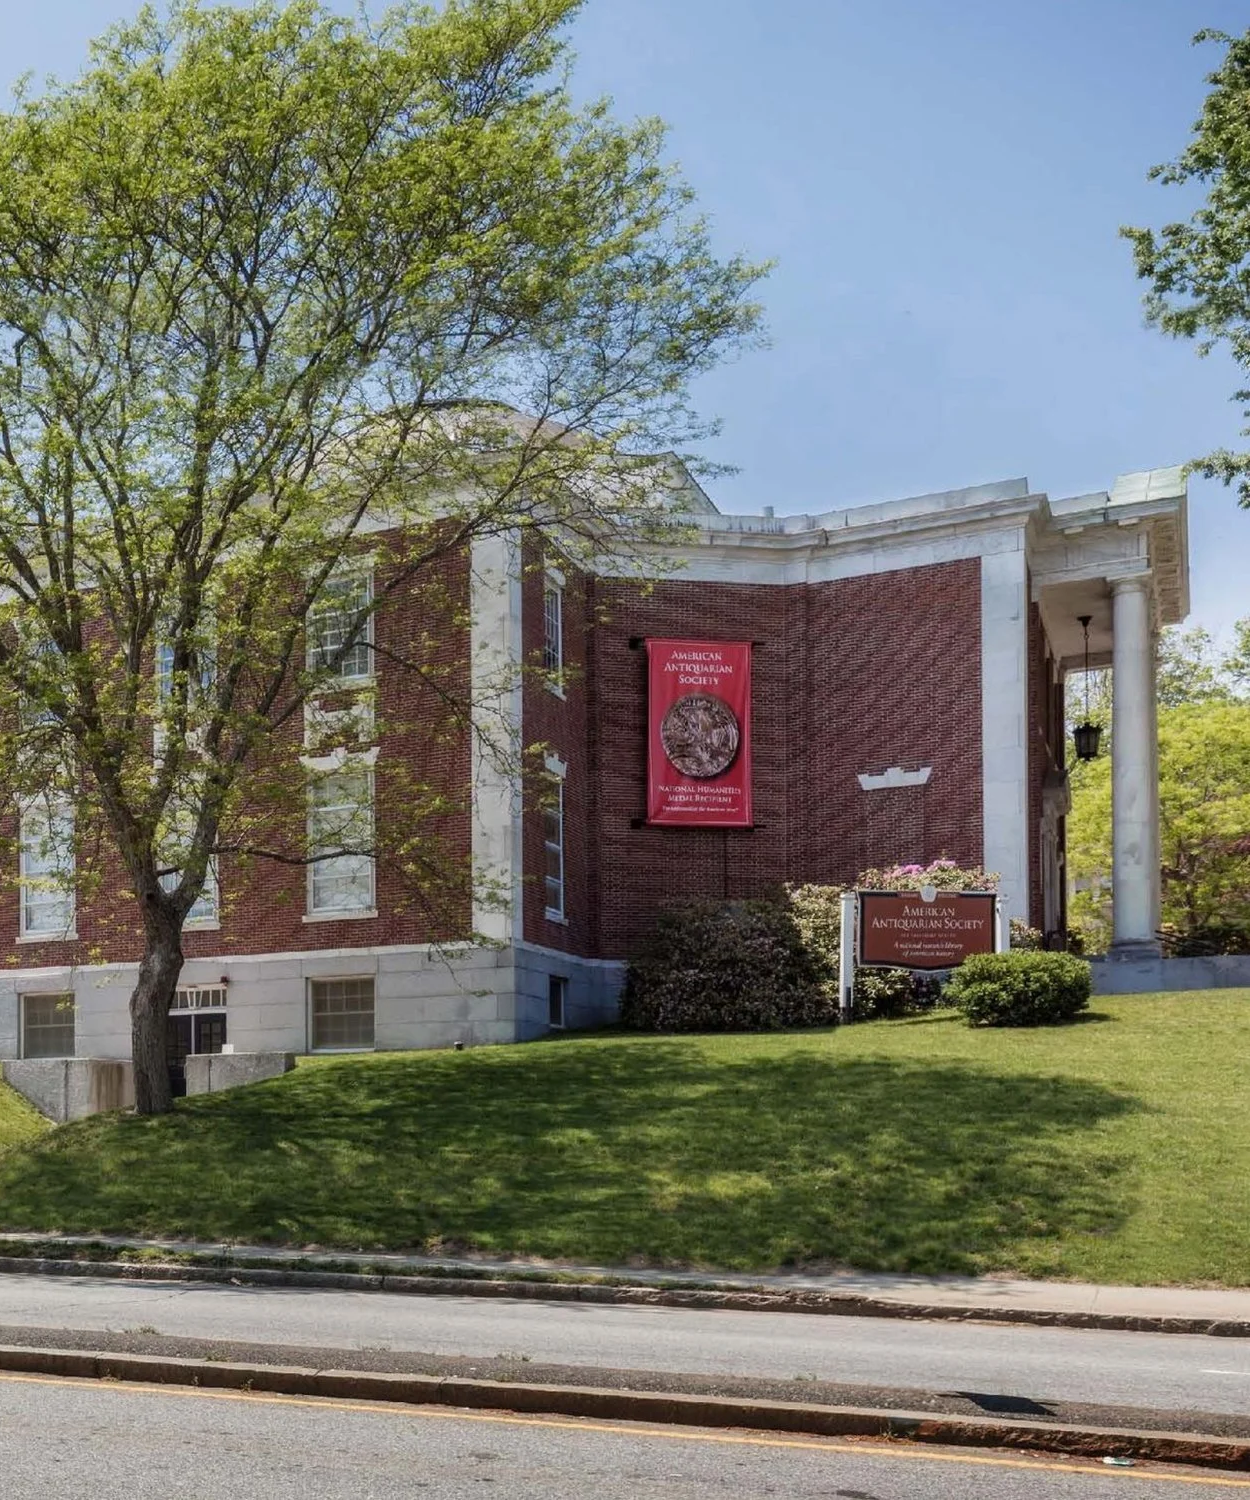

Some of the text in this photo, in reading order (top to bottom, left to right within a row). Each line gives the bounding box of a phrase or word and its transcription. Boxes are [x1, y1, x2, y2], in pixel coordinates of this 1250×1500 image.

[671, 651, 723, 661] AMERICAN
[664, 662, 733, 674] ANTIQUARIAN
[678, 675, 720, 686] SOCIETY
[658, 785, 695, 793] NATIONAL
[668, 794, 693, 802] MEDAL
[902, 905, 956, 917] AMERICAN
[872, 917, 985, 931] ANTIQUARIAN SOCIETY
